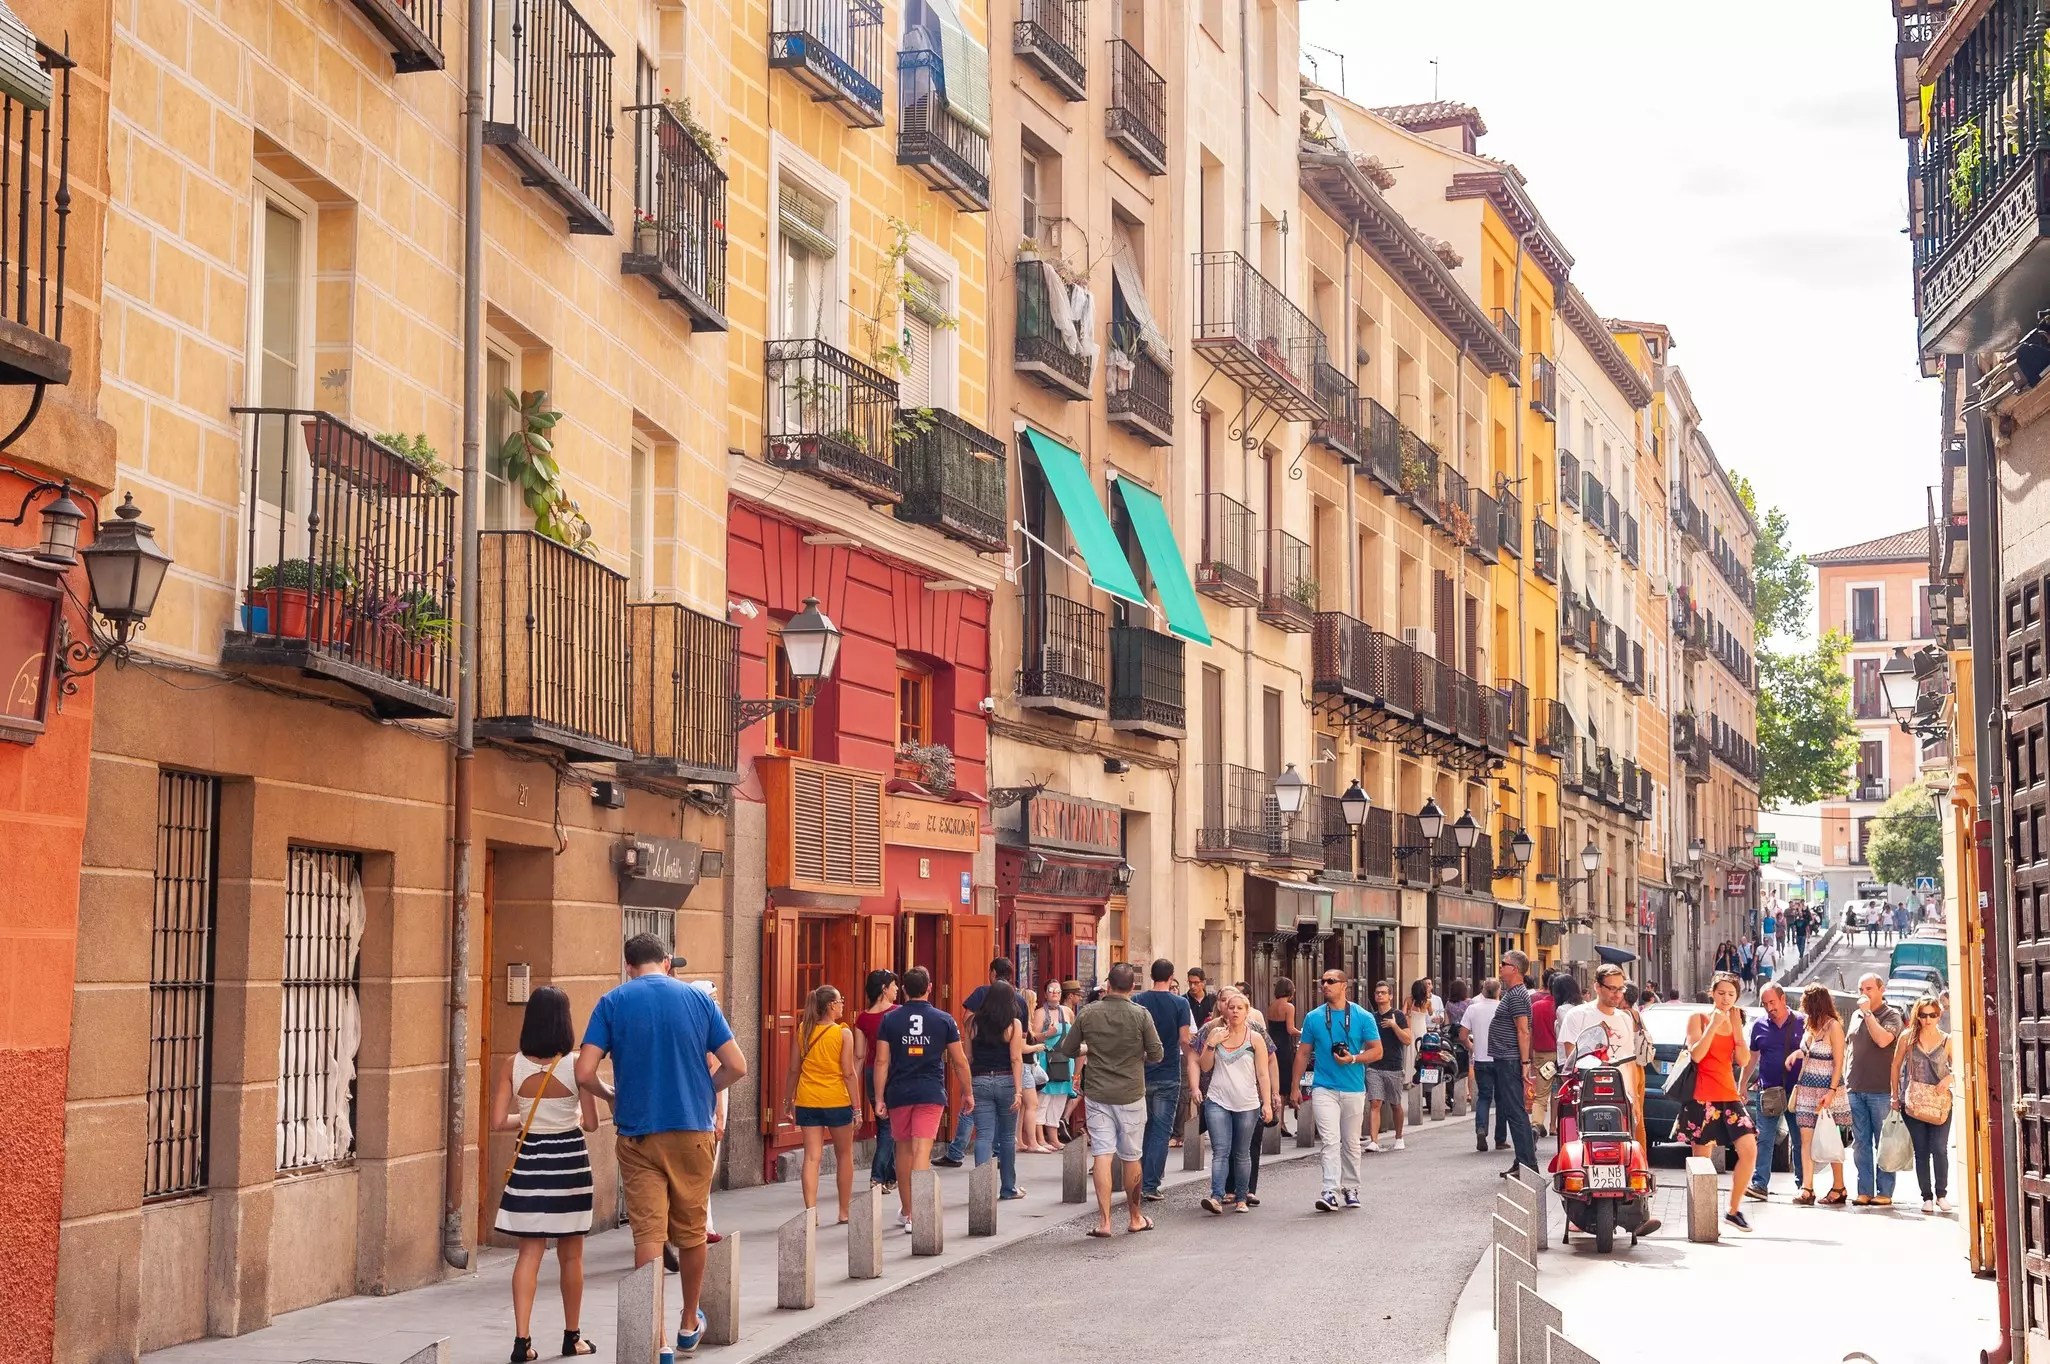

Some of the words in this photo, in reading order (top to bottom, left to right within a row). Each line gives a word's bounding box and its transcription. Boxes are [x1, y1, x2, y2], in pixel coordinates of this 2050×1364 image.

[18, 673, 39, 705] 25
[518, 783, 529, 807] 27
[926, 814, 936, 832] EL
[1030, 797, 1119, 848] RESTAURANTE
[1728, 873, 1746, 894] 47
[909, 1014, 923, 1036] 3
[901, 1035, 931, 1045] SPAIN
[1593, 1178, 1622, 1189] 2250
